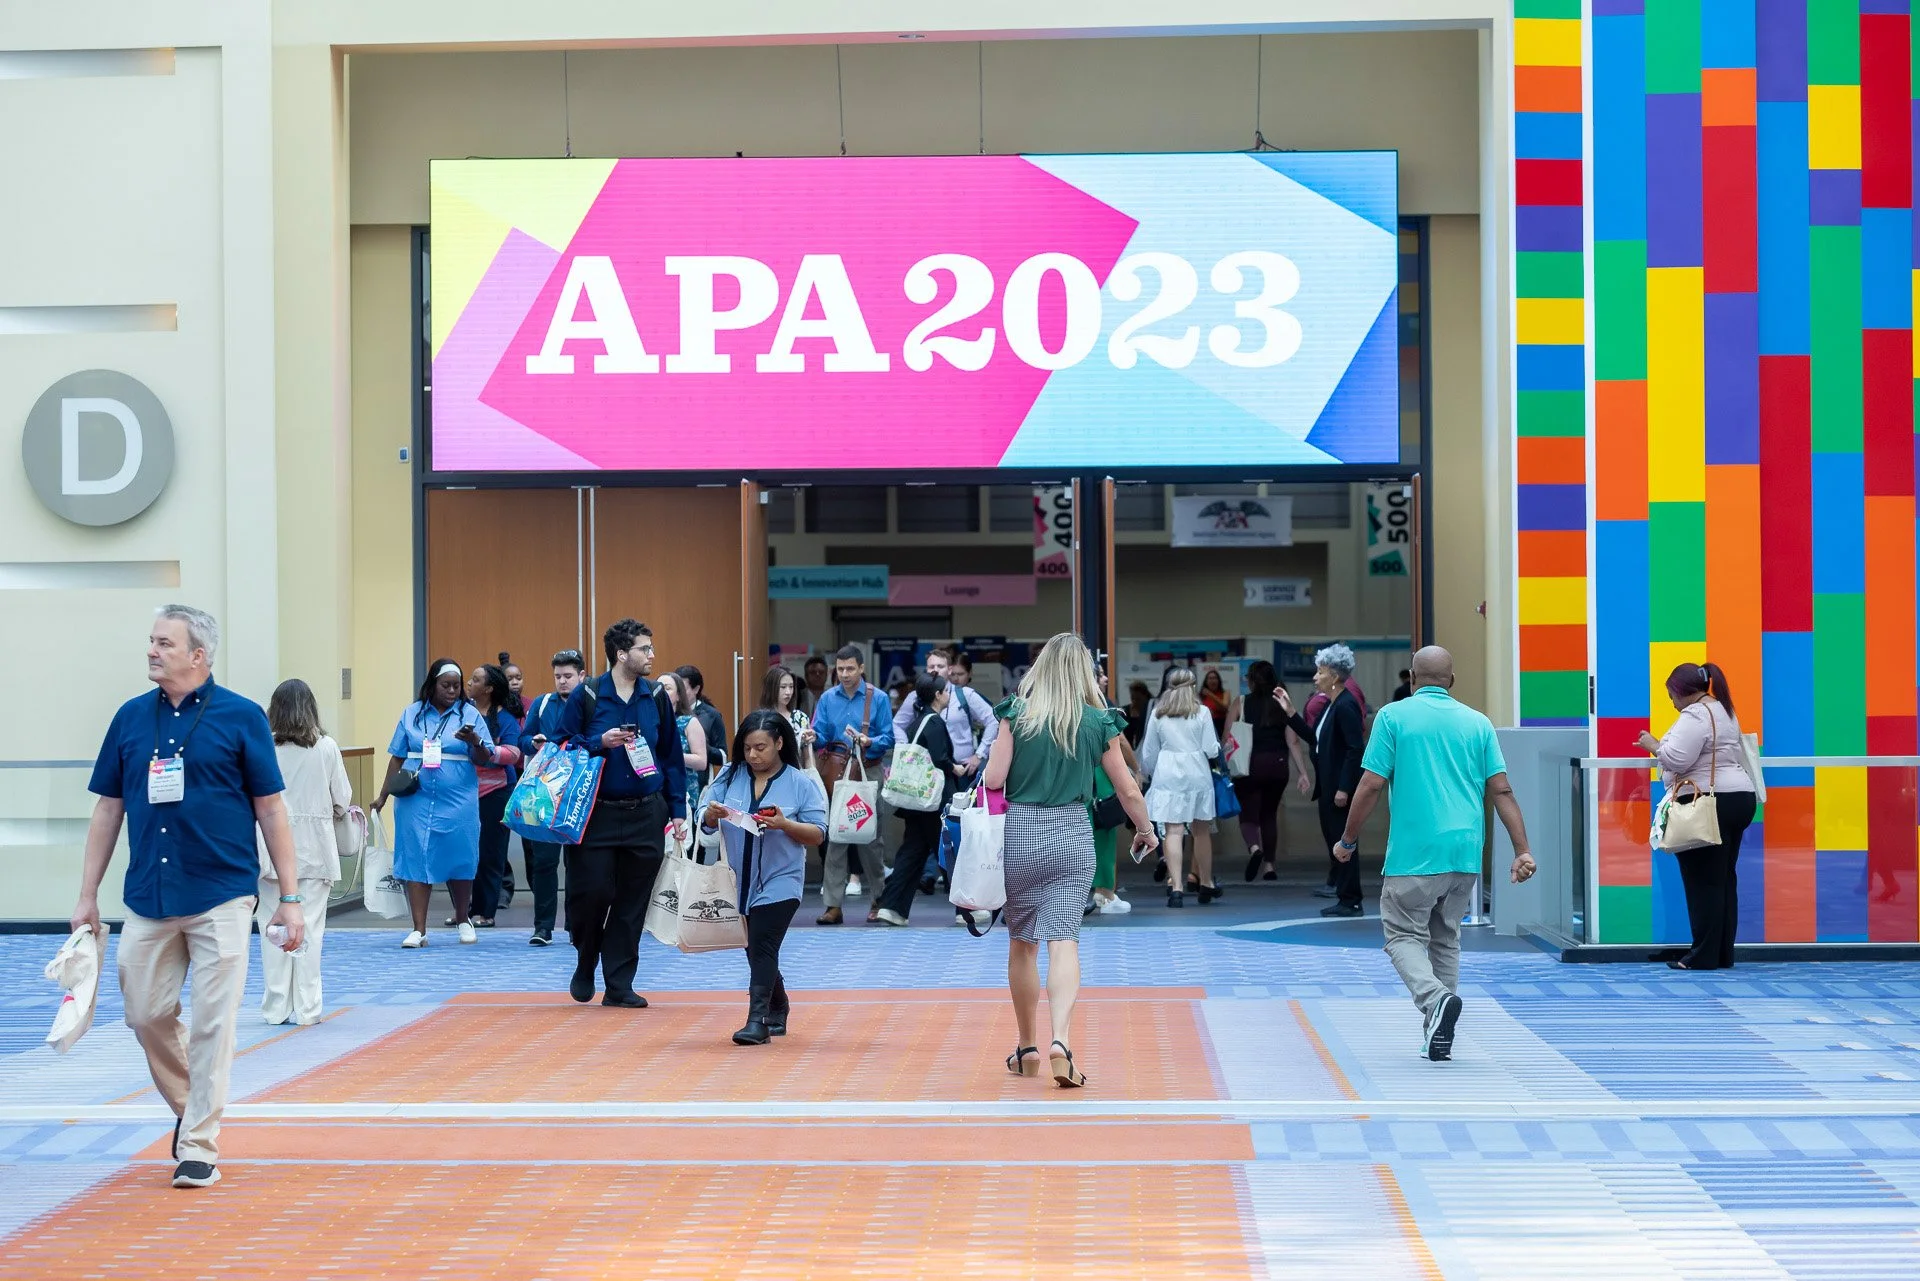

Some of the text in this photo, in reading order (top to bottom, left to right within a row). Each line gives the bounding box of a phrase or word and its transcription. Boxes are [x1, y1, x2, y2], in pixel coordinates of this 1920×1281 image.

[525, 250, 1303, 375] APA 2023
[62, 398, 143, 495] D
[1054, 493, 1072, 548] 400
[1387, 491, 1409, 543] 500
[768, 577, 788, 588] ech
[862, 576, 884, 588] Hub
[1038, 562, 1069, 574] 400
[1372, 560, 1402, 573] 500
[565, 769, 593, 829] HomeGood
[848, 809, 868, 821] 2023
